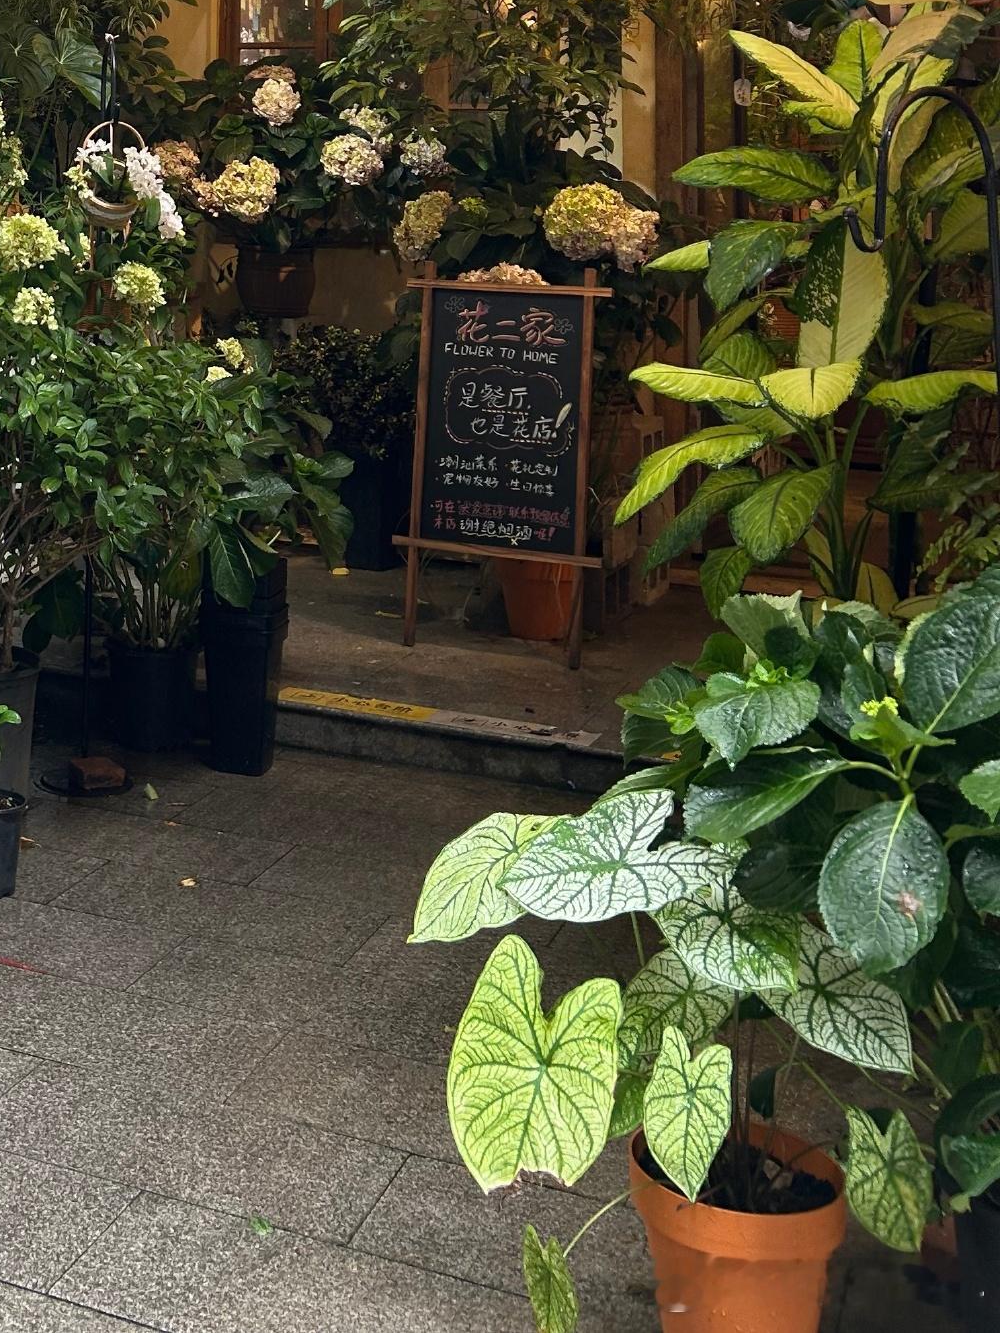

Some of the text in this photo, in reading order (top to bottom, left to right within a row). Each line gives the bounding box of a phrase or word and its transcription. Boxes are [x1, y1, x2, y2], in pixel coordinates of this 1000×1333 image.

[457, 300, 567, 347] 花二家
[444, 342, 559, 364] FLOWER TO HOME
[443, 472, 499, 489] 宠物友好
